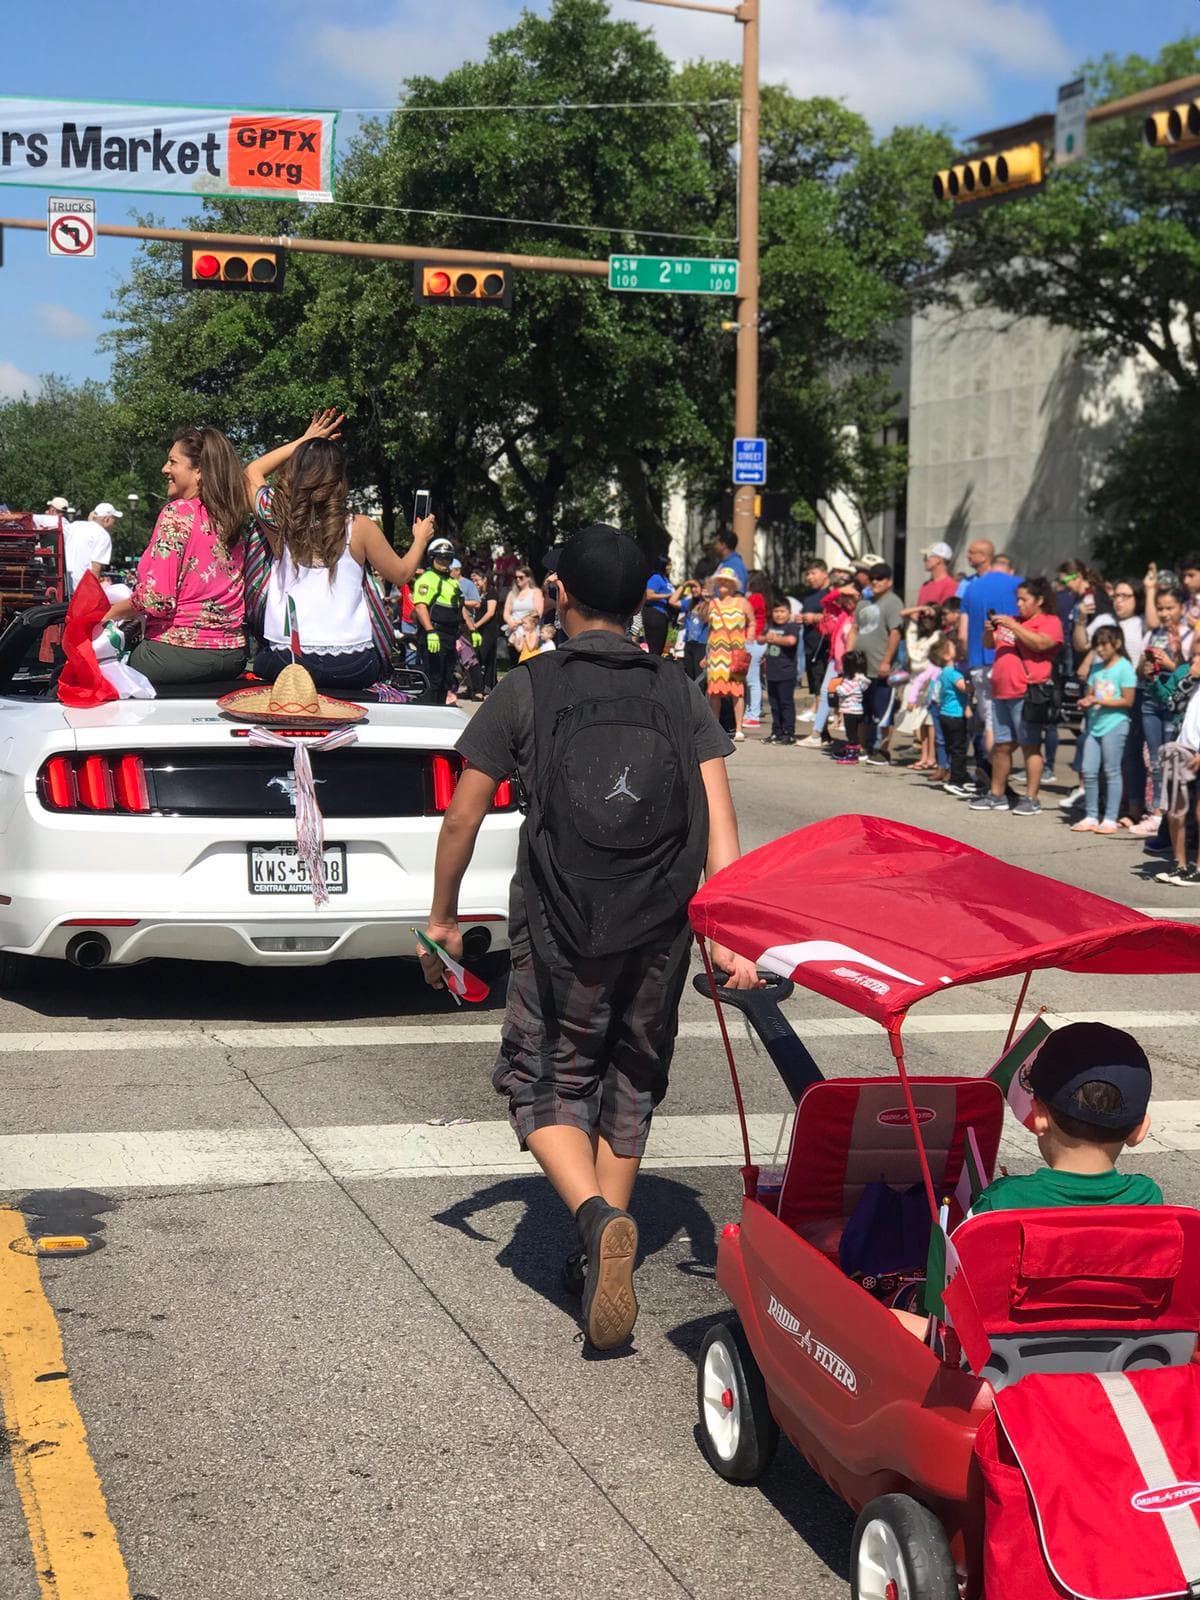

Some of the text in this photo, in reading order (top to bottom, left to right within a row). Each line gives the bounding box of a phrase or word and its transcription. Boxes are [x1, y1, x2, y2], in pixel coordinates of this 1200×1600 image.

[60, 122, 221, 177] Market
[237, 128, 317, 152] GPTX
[248, 160, 302, 185] .org
[53, 202, 92, 212] TRUCKS
[622, 260, 638, 271] SW
[709, 264, 726, 275] NW
[616, 275, 731, 290] 100 100
[254, 884, 287, 892] CENTRAL
[767, 1295, 801, 1332] RADIO
[813, 1344, 857, 1392] FLYER
